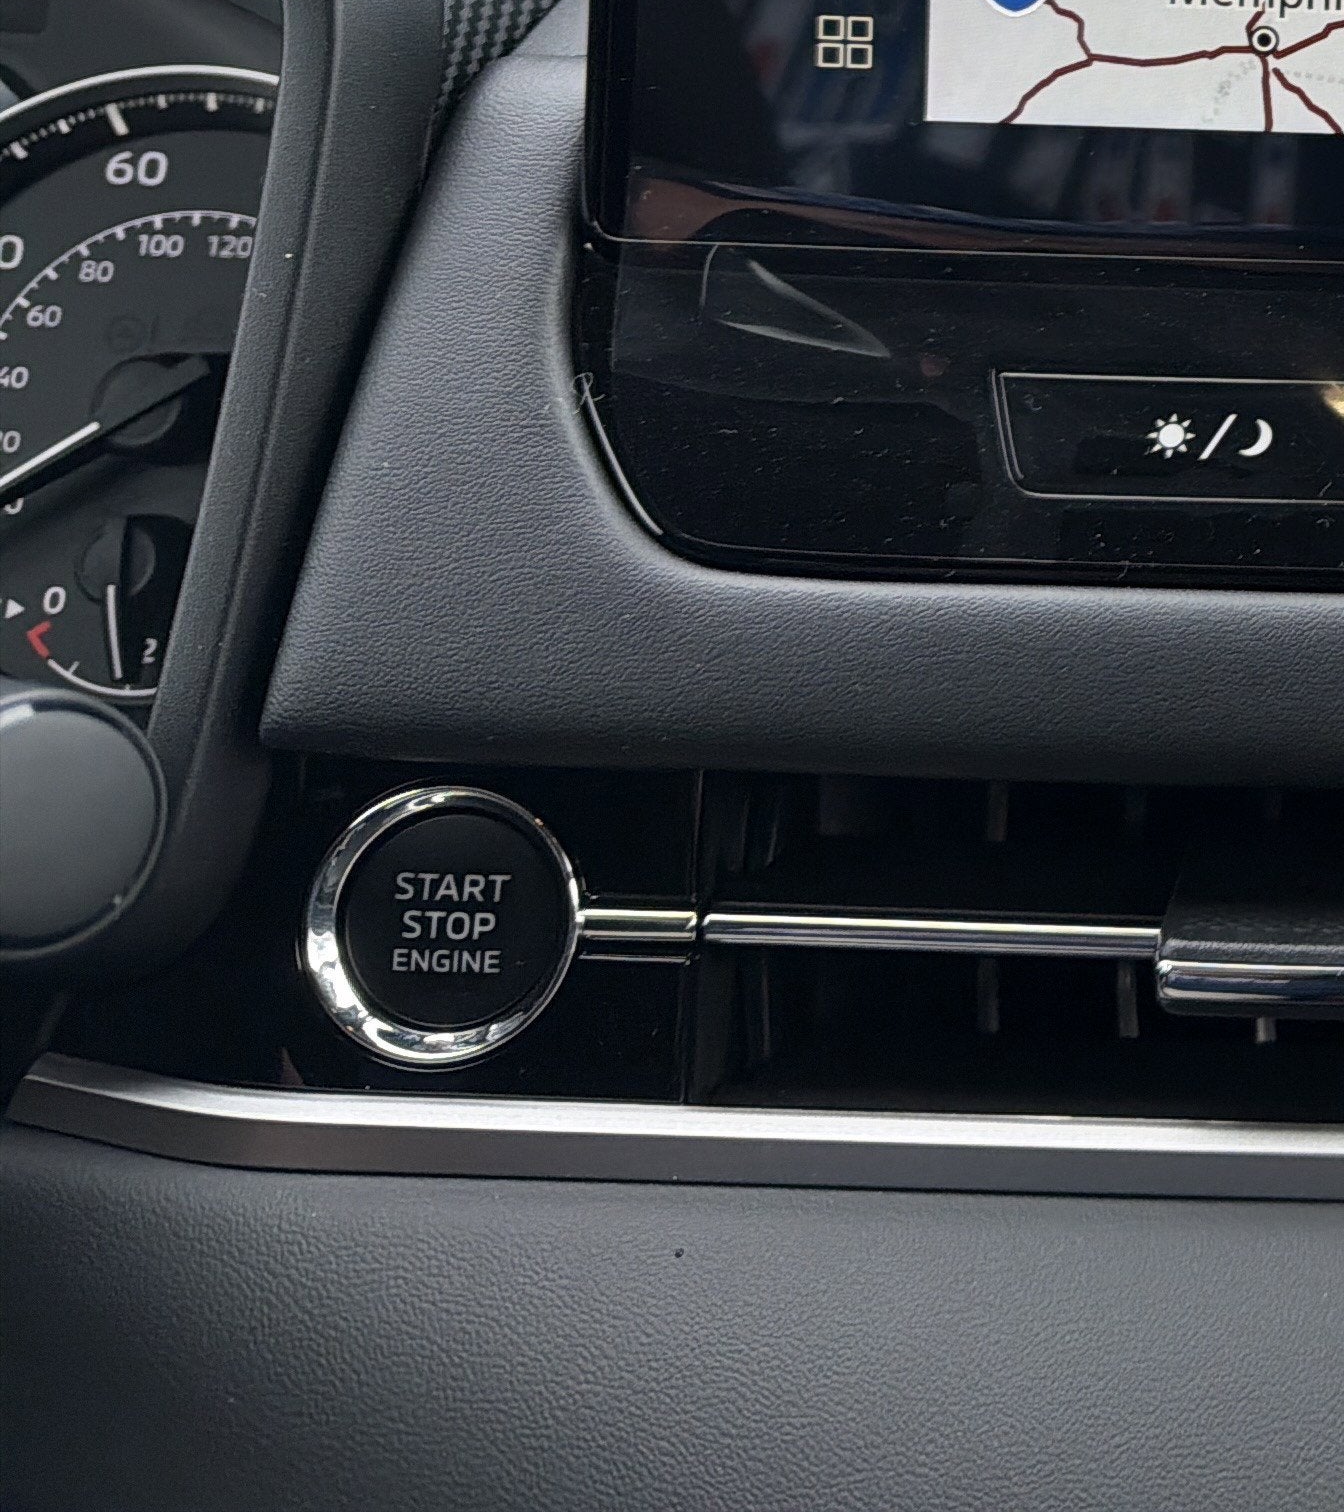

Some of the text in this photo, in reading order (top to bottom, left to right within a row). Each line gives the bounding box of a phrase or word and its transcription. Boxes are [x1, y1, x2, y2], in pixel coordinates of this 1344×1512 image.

[105, 151, 168, 186] 60
[139, 235, 185, 257] 100
[207, 235, 252, 258] 120
[79, 261, 114, 282] 80
[27, 305, 62, 327] 60
[43, 586, 66, 615] 0
[395, 872, 512, 903] START
[402, 910, 496, 941] STOP
[392, 949, 500, 974] ENGINE
